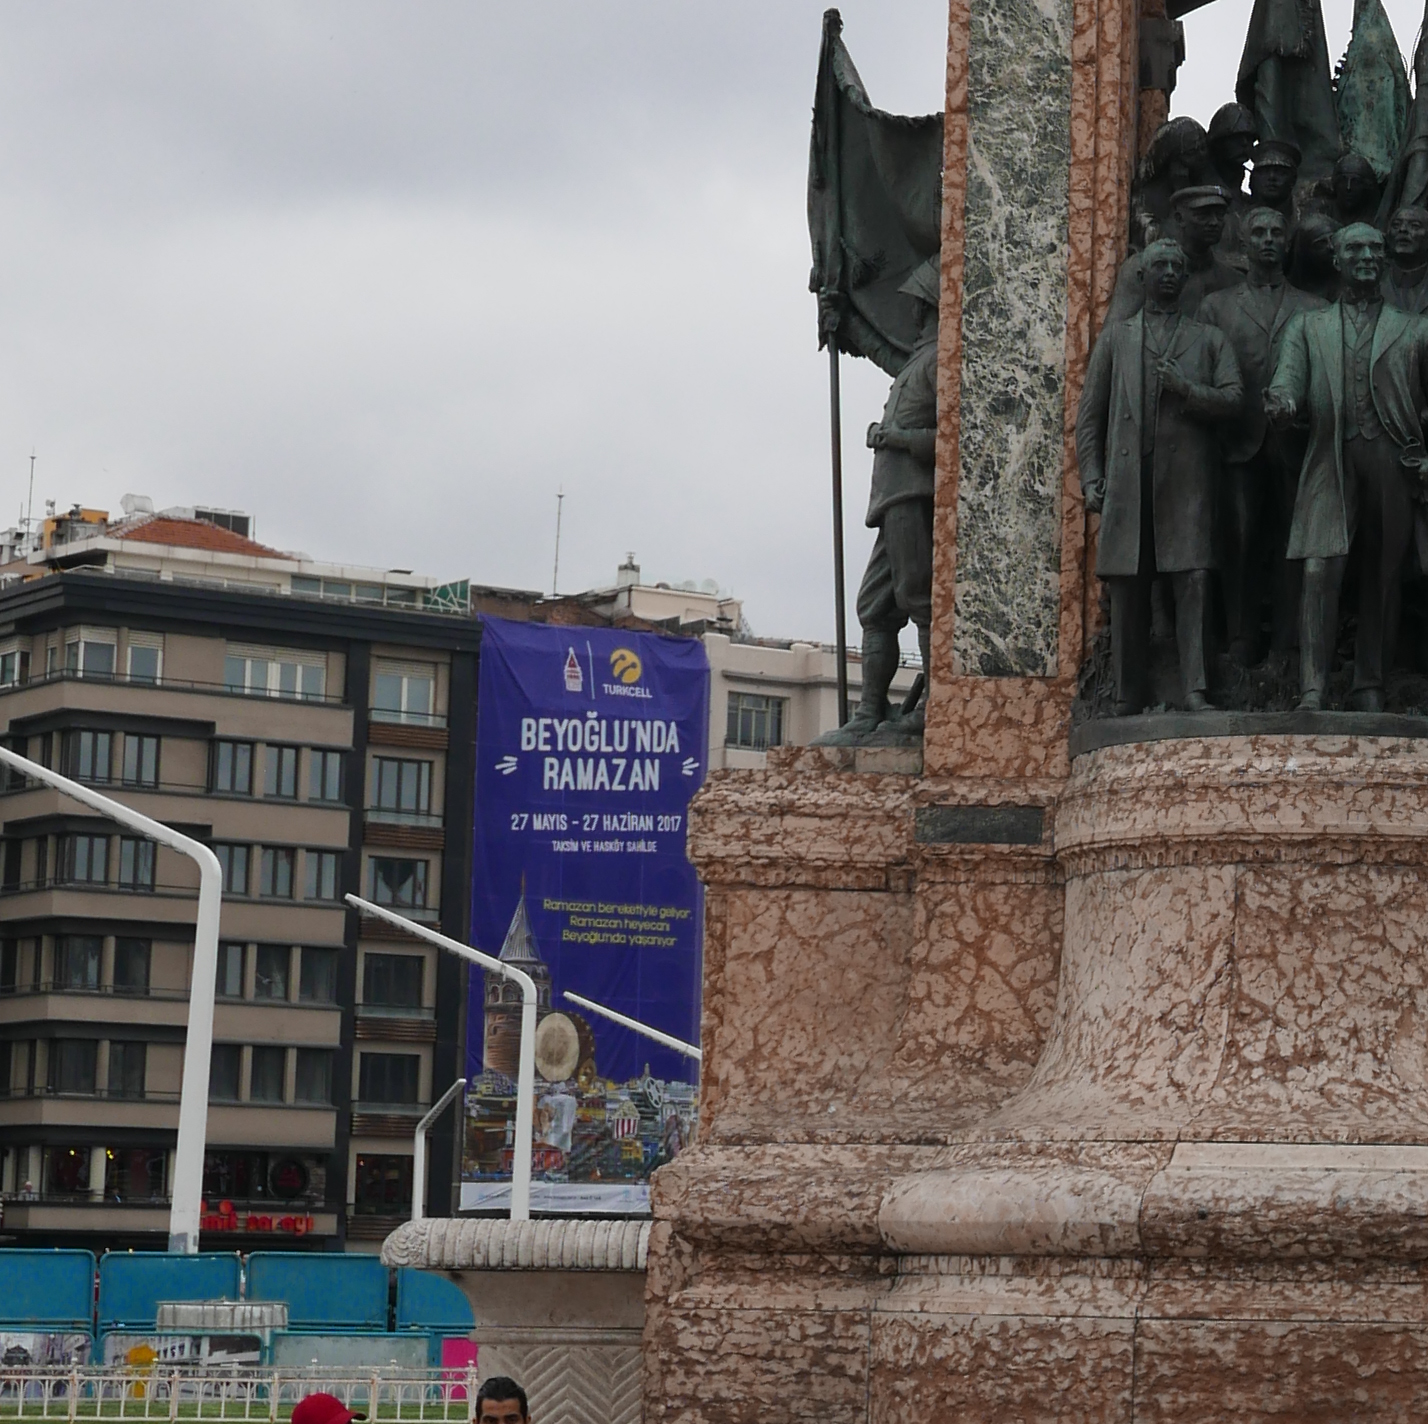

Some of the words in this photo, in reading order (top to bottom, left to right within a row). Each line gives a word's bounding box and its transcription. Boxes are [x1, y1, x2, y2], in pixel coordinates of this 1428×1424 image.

[602, 683, 653, 698] TURKCELL
[521, 711, 680, 753] BEYOĞLU'NDA
[543, 757, 660, 791] RAMAZAN
[511, 813, 529, 830] 27
[533, 813, 568, 831] MAYIS
[583, 814, 599, 831] 27
[603, 811, 654, 832] HAZİRAN
[657, 815, 682, 832] 2017
[552, 838, 579, 852] TAKSİM
[580, 840, 592, 852] VE
[593, 838, 625, 852] HASKÖY
[543, 898, 596, 912] Ramazan
[570, 915, 622, 928] Ramazan
[624, 918, 670, 932] heyecanı
[629, 934, 678, 948] yaşanıyor
